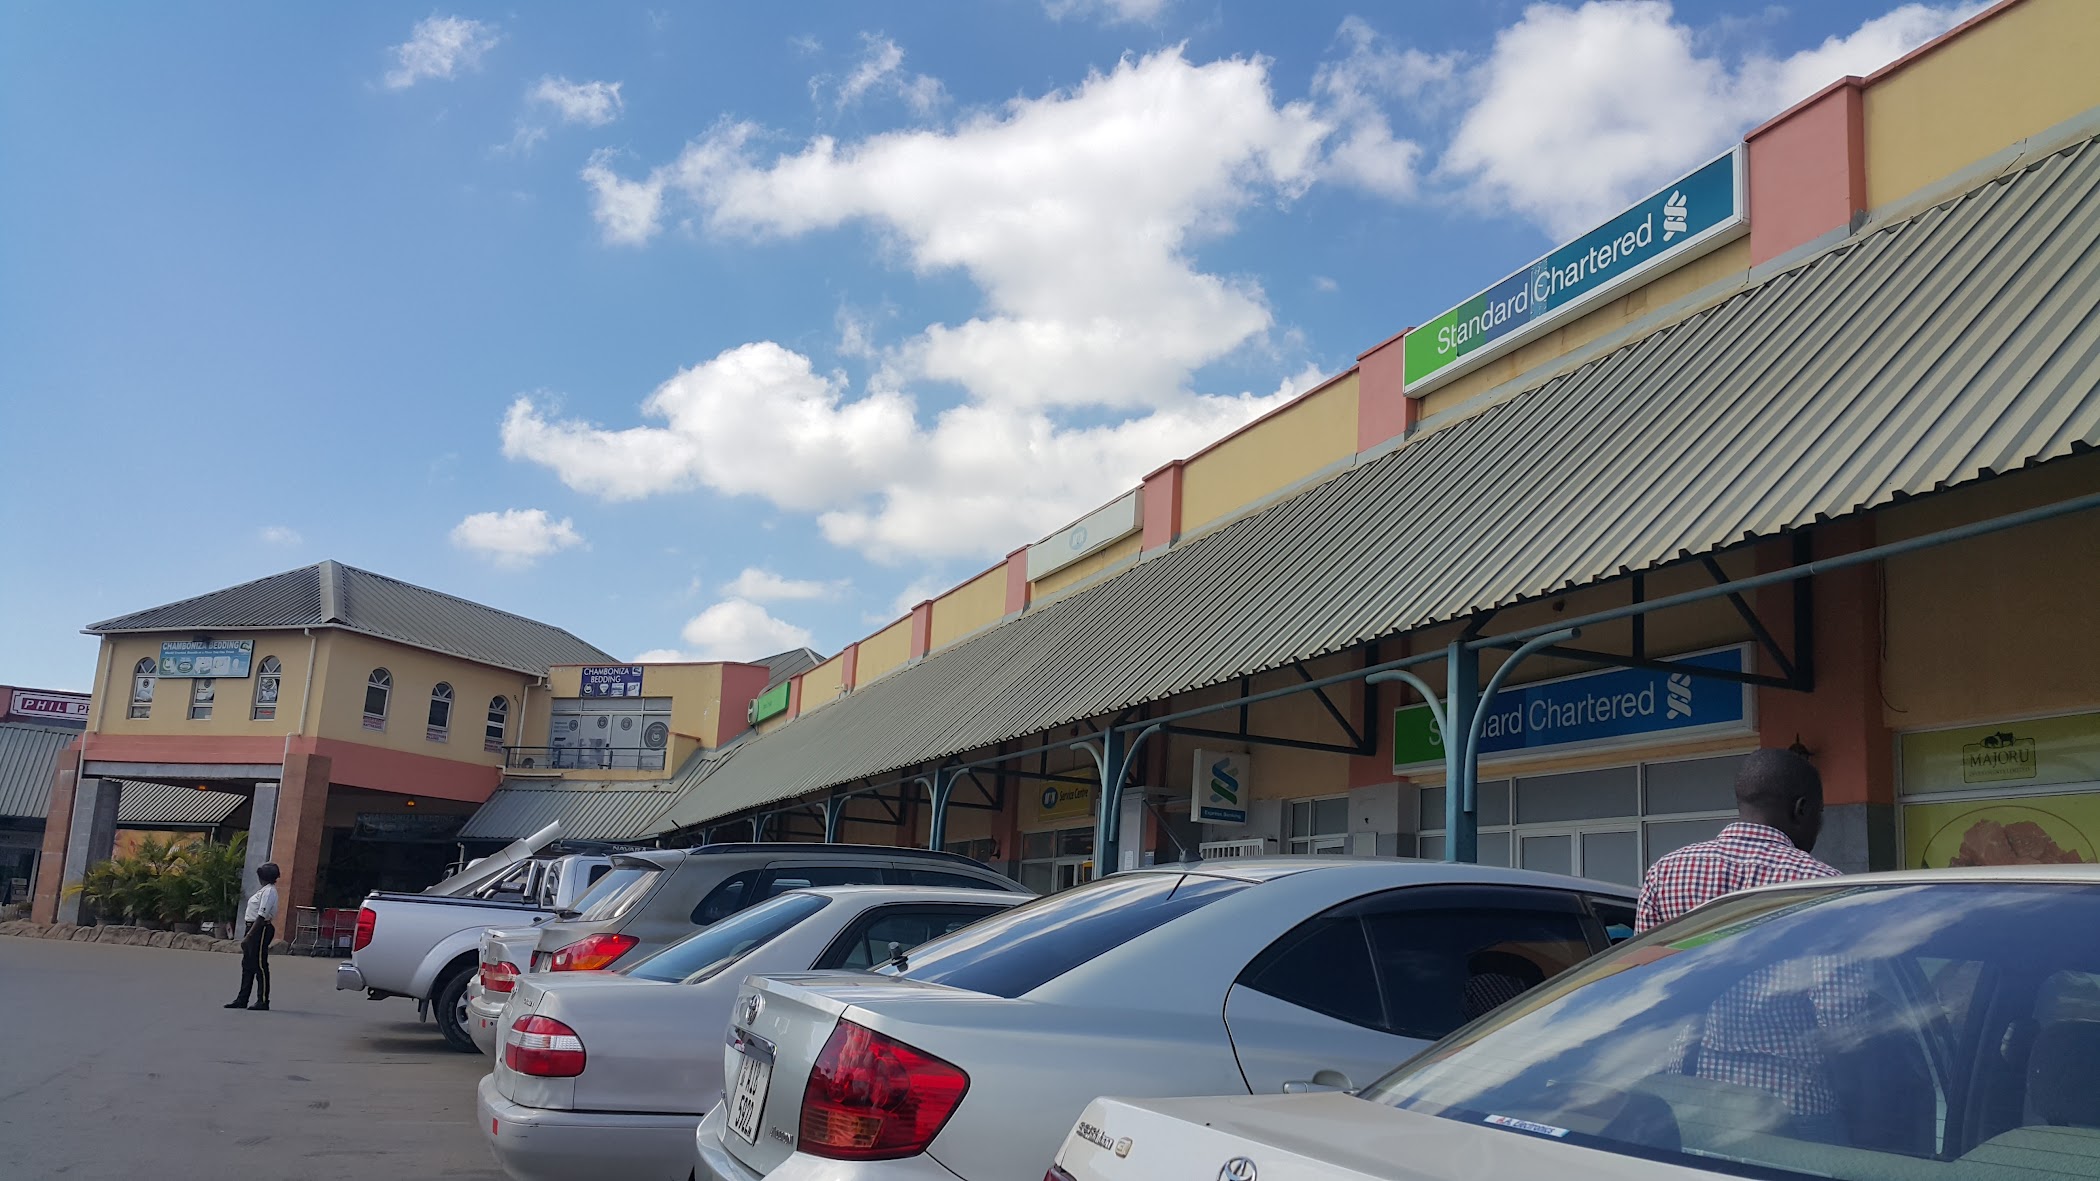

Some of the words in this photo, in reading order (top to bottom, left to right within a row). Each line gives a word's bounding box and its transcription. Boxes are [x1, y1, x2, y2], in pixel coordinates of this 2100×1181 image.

[1437, 283, 1529, 355] Standard
[1533, 213, 1652, 303] Chartered
[208, 640, 239, 650] BEDDING
[583, 667, 629, 676] CHAMBONIZA
[590, 675, 621, 683] BEDDING
[23, 699, 64, 712] PHIL
[1429, 703, 1522, 746] Sard
[1529, 682, 1655, 732] Chartered
[1970, 749, 2029, 768] MAJORU
[1059, 790, 1074, 801] Service
[1075, 787, 1089, 799] Centre
